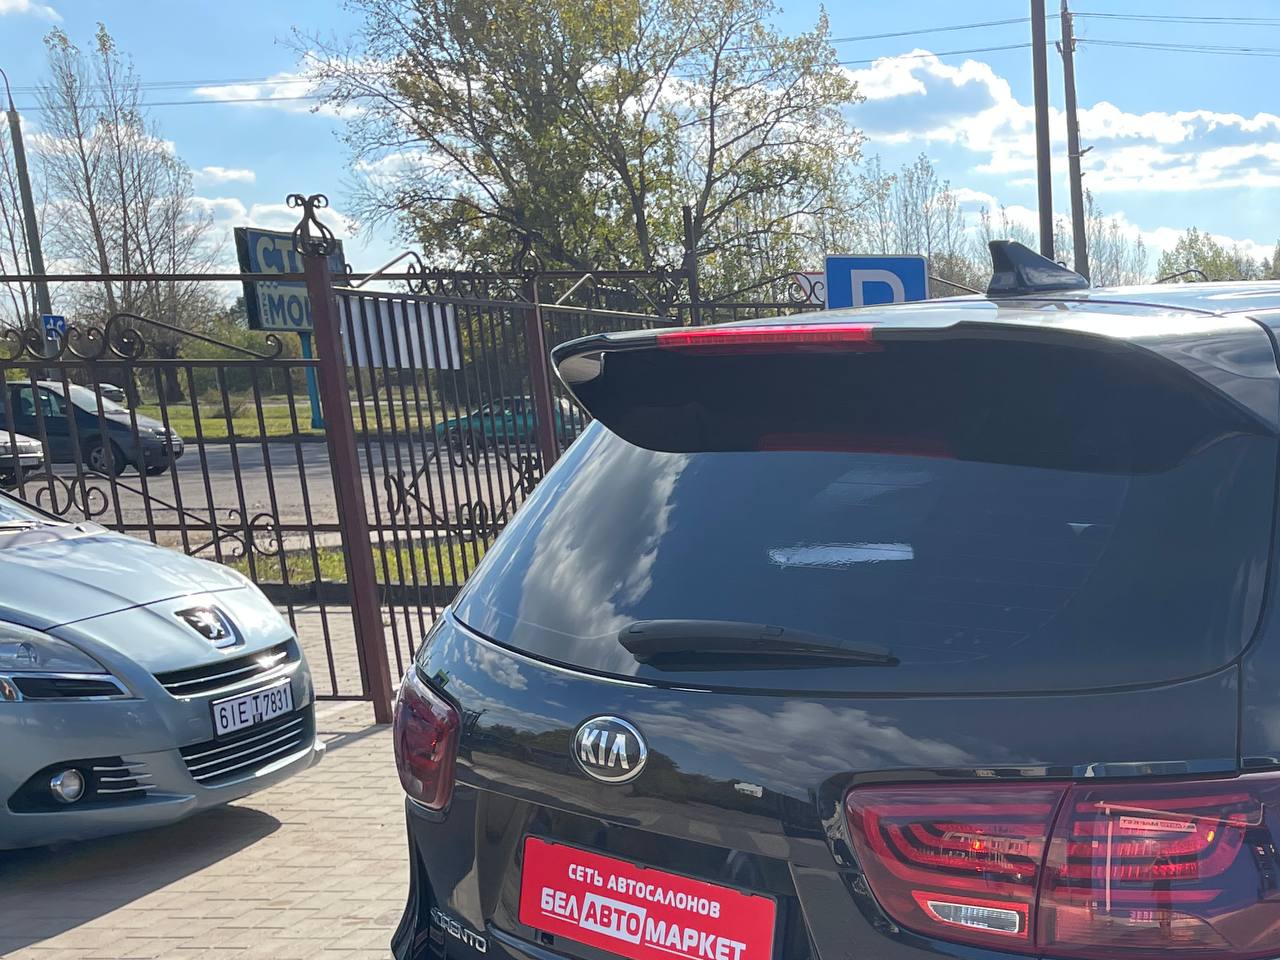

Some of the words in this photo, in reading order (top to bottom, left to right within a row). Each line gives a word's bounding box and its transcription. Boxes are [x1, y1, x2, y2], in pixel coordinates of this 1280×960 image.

[580, 727, 630, 770] KIA
[568, 863, 604, 887] СЕТЬ
[606, 874, 720, 918] АВТОСАЛОНОВ
